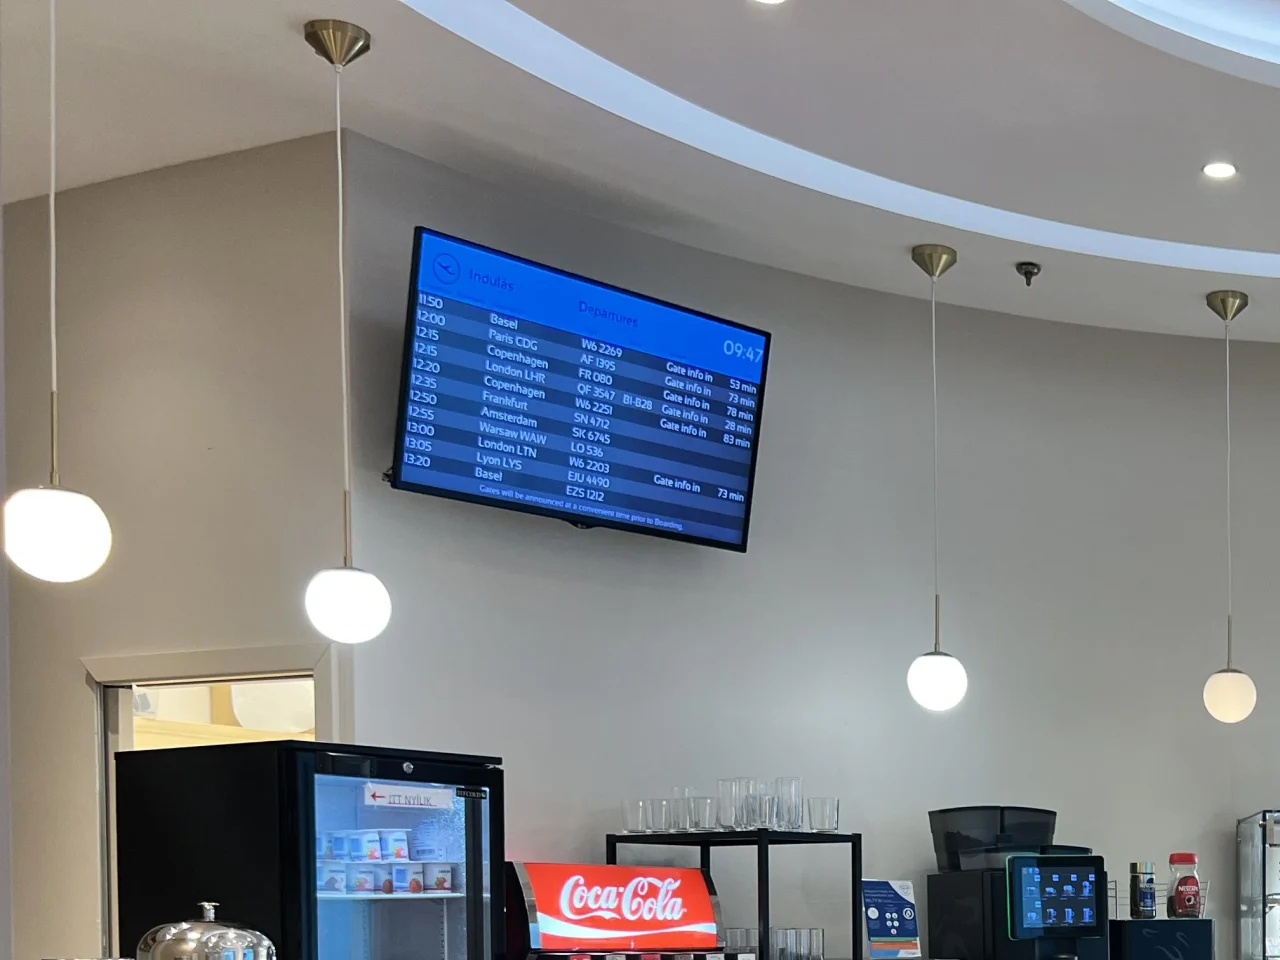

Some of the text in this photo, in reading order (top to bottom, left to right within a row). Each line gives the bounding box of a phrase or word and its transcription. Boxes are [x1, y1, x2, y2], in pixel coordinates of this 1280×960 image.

[470, 268, 514, 292] Indulás
[578, 300, 638, 328] Departures
[488, 328, 514, 344] Paris
[516, 336, 538, 350] CDG
[580, 353, 594, 365] AF
[596, 357, 616, 372] 1395
[664, 376, 684, 390] Gate
[686, 381, 702, 394] info
[702, 384, 712, 397] in
[728, 392, 739, 404] 73
[740, 396, 756, 408] min
[490, 312, 518, 330] Basel
[581, 338, 598, 352] W6
[599, 342, 622, 358] 2269
[666, 361, 686, 376] Gate
[688, 367, 704, 380] info
[704, 370, 713, 382] in
[730, 378, 740, 390] 53
[742, 382, 756, 395] min
[724, 340, 764, 362] 09:47
[486, 344, 548, 370] Copenhagen
[578, 368, 592, 380] FR
[593, 371, 613, 386] 080
[663, 390, 682, 404] Gate
[684, 396, 700, 408] info
[700, 398, 710, 411] in
[726, 406, 737, 418] 78
[738, 409, 754, 422] min
[486, 360, 522, 378] London
[524, 370, 546, 384] LHR
[577, 383, 592, 395] QF
[592, 386, 616, 400] 3547
[662, 404, 681, 418] Gate
[683, 409, 699, 422] info
[700, 412, 708, 424] in
[724, 420, 736, 431] 28
[736, 424, 752, 435] min
[480, 406, 538, 428] Amsterdam
[572, 427, 586, 438] SK
[588, 430, 610, 445] 6745
[482, 390, 528, 411] Frankfurt
[574, 412, 588, 425] SN
[589, 415, 610, 430] 4712
[484, 375, 546, 400] Copenhagen
[575, 397, 592, 410] W6
[592, 400, 613, 416] 2251
[660, 418, 680, 432] Gate
[680, 423, 697, 436] info
[698, 426, 706, 438] in
[724, 434, 734, 445] 83
[735, 436, 750, 449] min
[479, 422, 518, 440] Warsaw
[518, 431, 547, 446] WAW
[570, 442, 585, 453] LO
[586, 444, 604, 458] 536
[475, 466, 502, 482] Basel
[566, 485, 585, 498] EZS
[586, 488, 605, 502] 1212
[476, 452, 500, 467] Lyon
[502, 456, 522, 470] LYS
[568, 471, 585, 483] EJU
[586, 474, 610, 488] 4490
[478, 436, 515, 454] London
[516, 446, 538, 459] LTN
[568, 456, 585, 468] W6
[586, 458, 610, 474] 2203
[654, 474, 674, 488] Gate
[674, 478, 691, 491] info
[692, 482, 700, 494] in
[718, 488, 728, 499] 73
[728, 490, 744, 503] min
[480, 484, 500, 496] Gates
[501, 488, 514, 498] will
[514, 490, 524, 500] be
[524, 494, 564, 508] announced
[564, 501, 572, 510] at
[578, 504, 615, 518] convenient
[616, 510, 630, 521] time
[631, 513, 646, 524] prior
[646, 516, 654, 525] to
[560, 875, 682, 920] Coca-Cola
